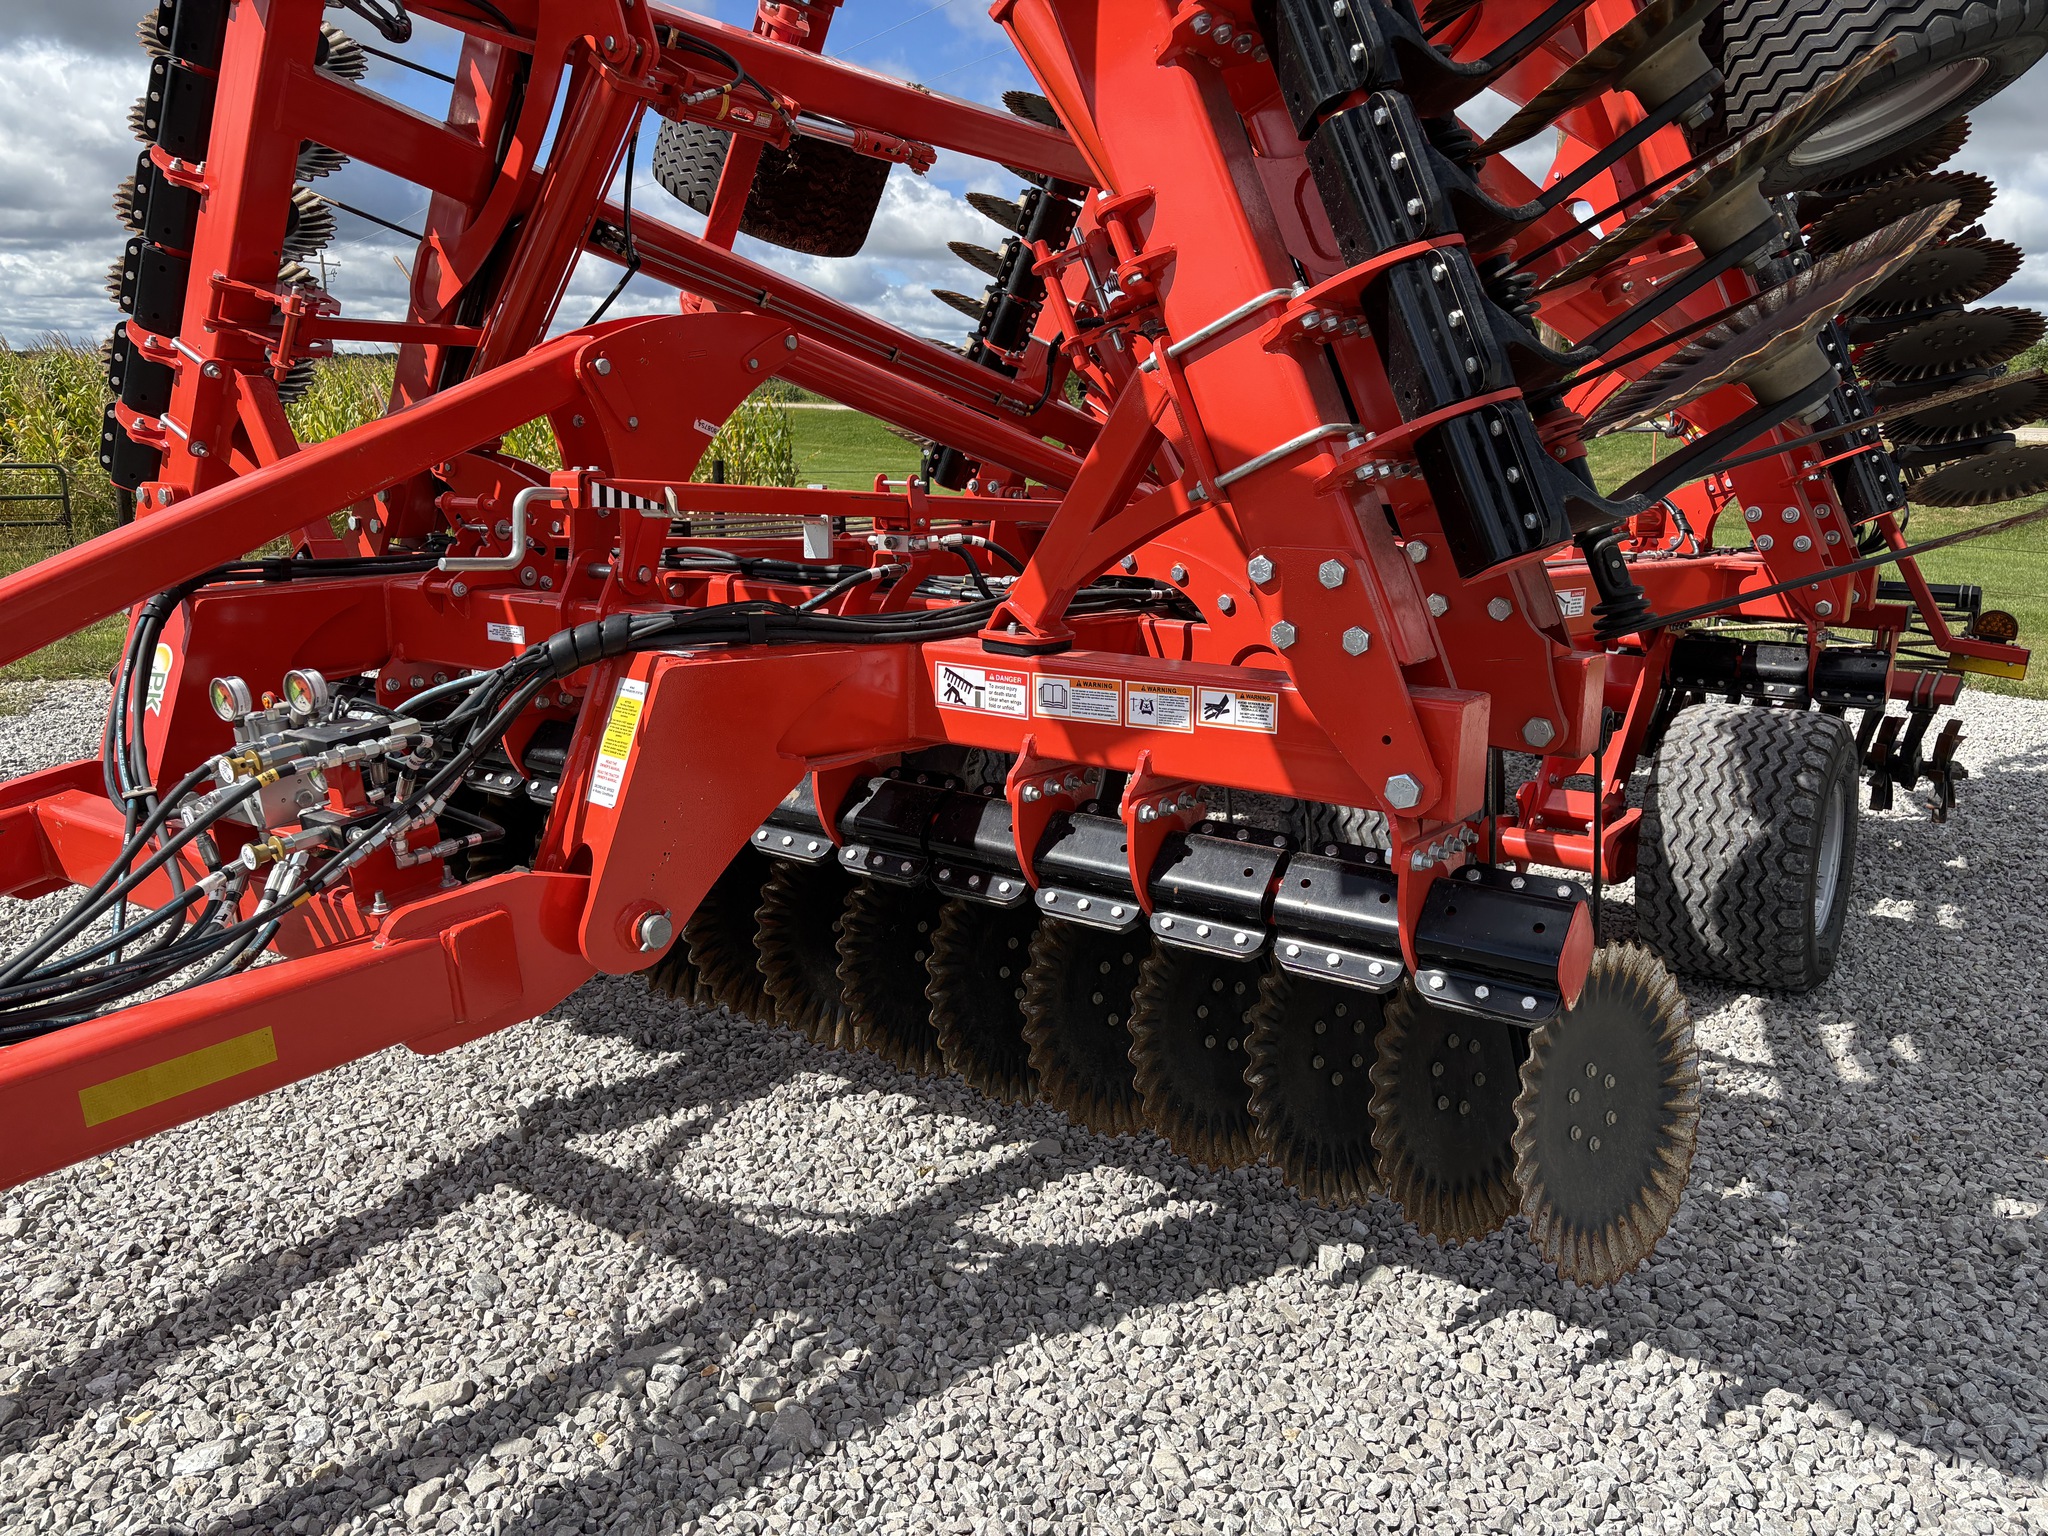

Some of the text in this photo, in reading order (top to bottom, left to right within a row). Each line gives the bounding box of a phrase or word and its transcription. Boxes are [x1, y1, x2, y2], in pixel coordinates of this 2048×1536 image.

[995, 674, 1022, 684] DANGER
[1083, 680, 1113, 689] WARNING
[1147, 686, 1177, 694] WARNING
